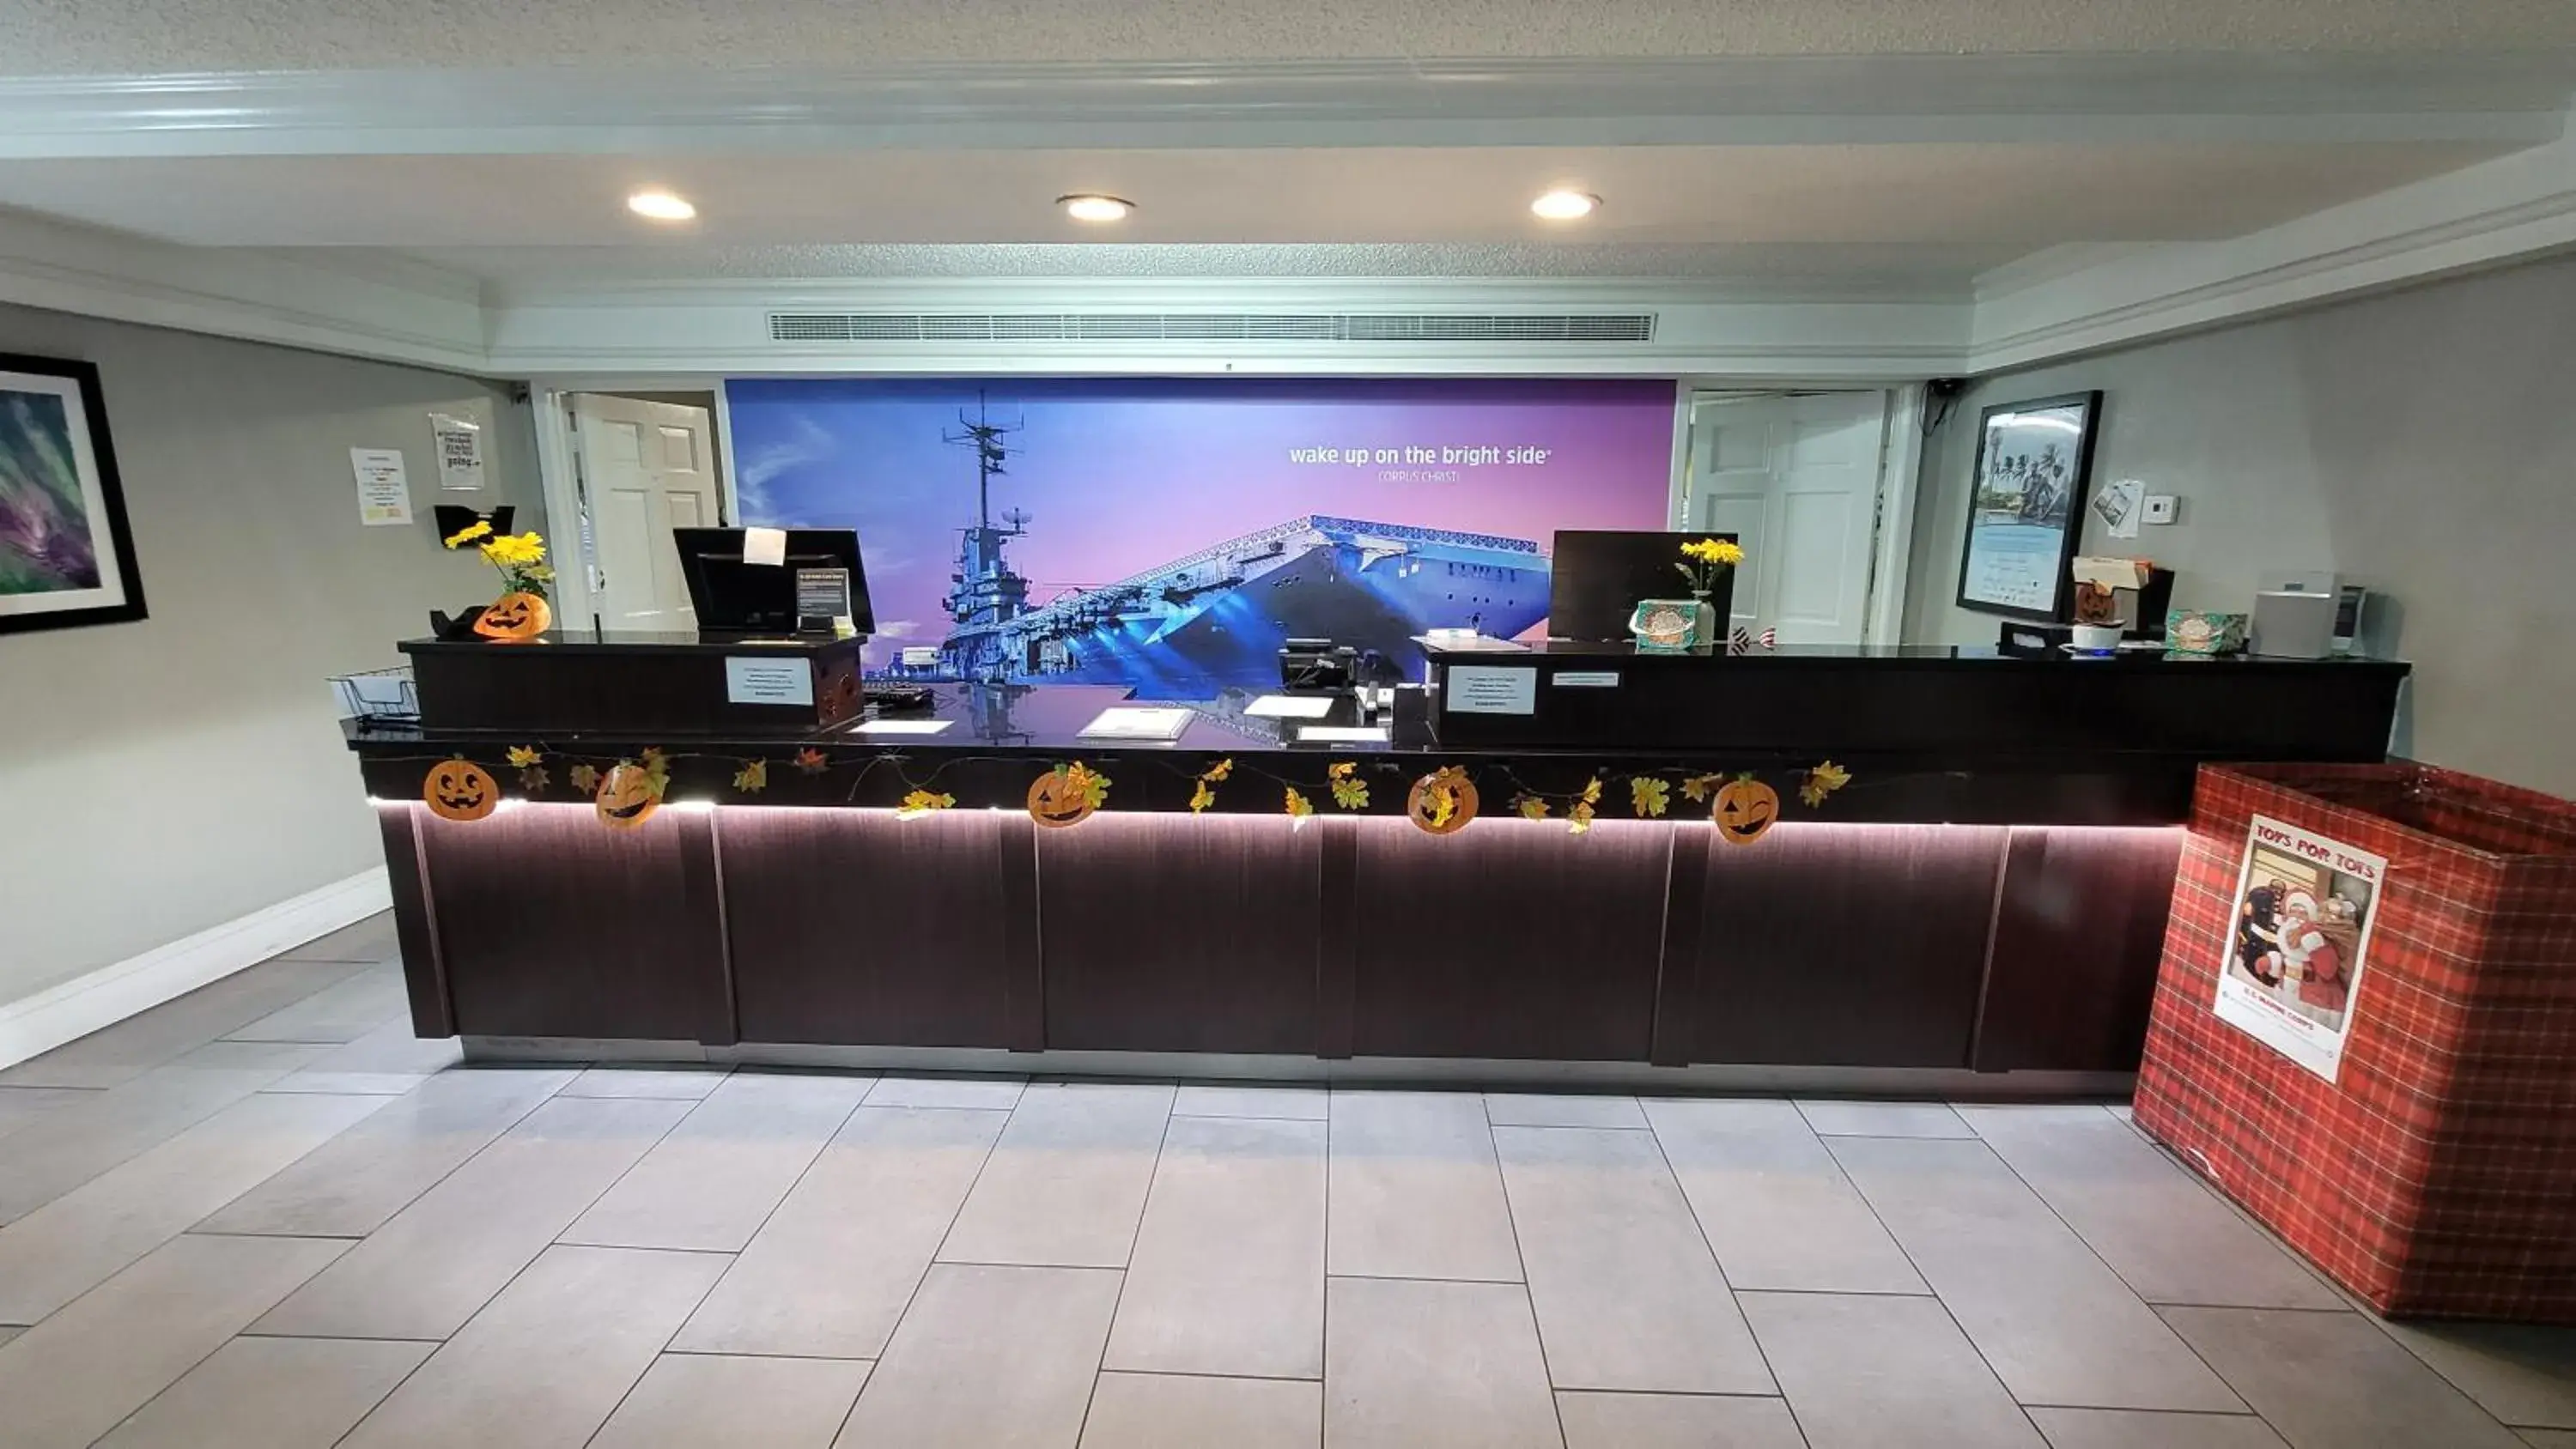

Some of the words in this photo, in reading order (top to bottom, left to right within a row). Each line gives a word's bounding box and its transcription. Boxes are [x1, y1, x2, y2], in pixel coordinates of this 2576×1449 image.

[1290, 446, 1339, 464] wake
[1345, 449, 1370, 467] up
[1375, 450, 1399, 464] on
[1405, 446, 1436, 464] the
[1442, 446, 1501, 467] bright
[1378, 470, 1419, 482] CORPUS
[2257, 824, 2292, 847] TOYS
[2297, 840, 2331, 863] FOR
[2336, 852, 2375, 878] TOTS
